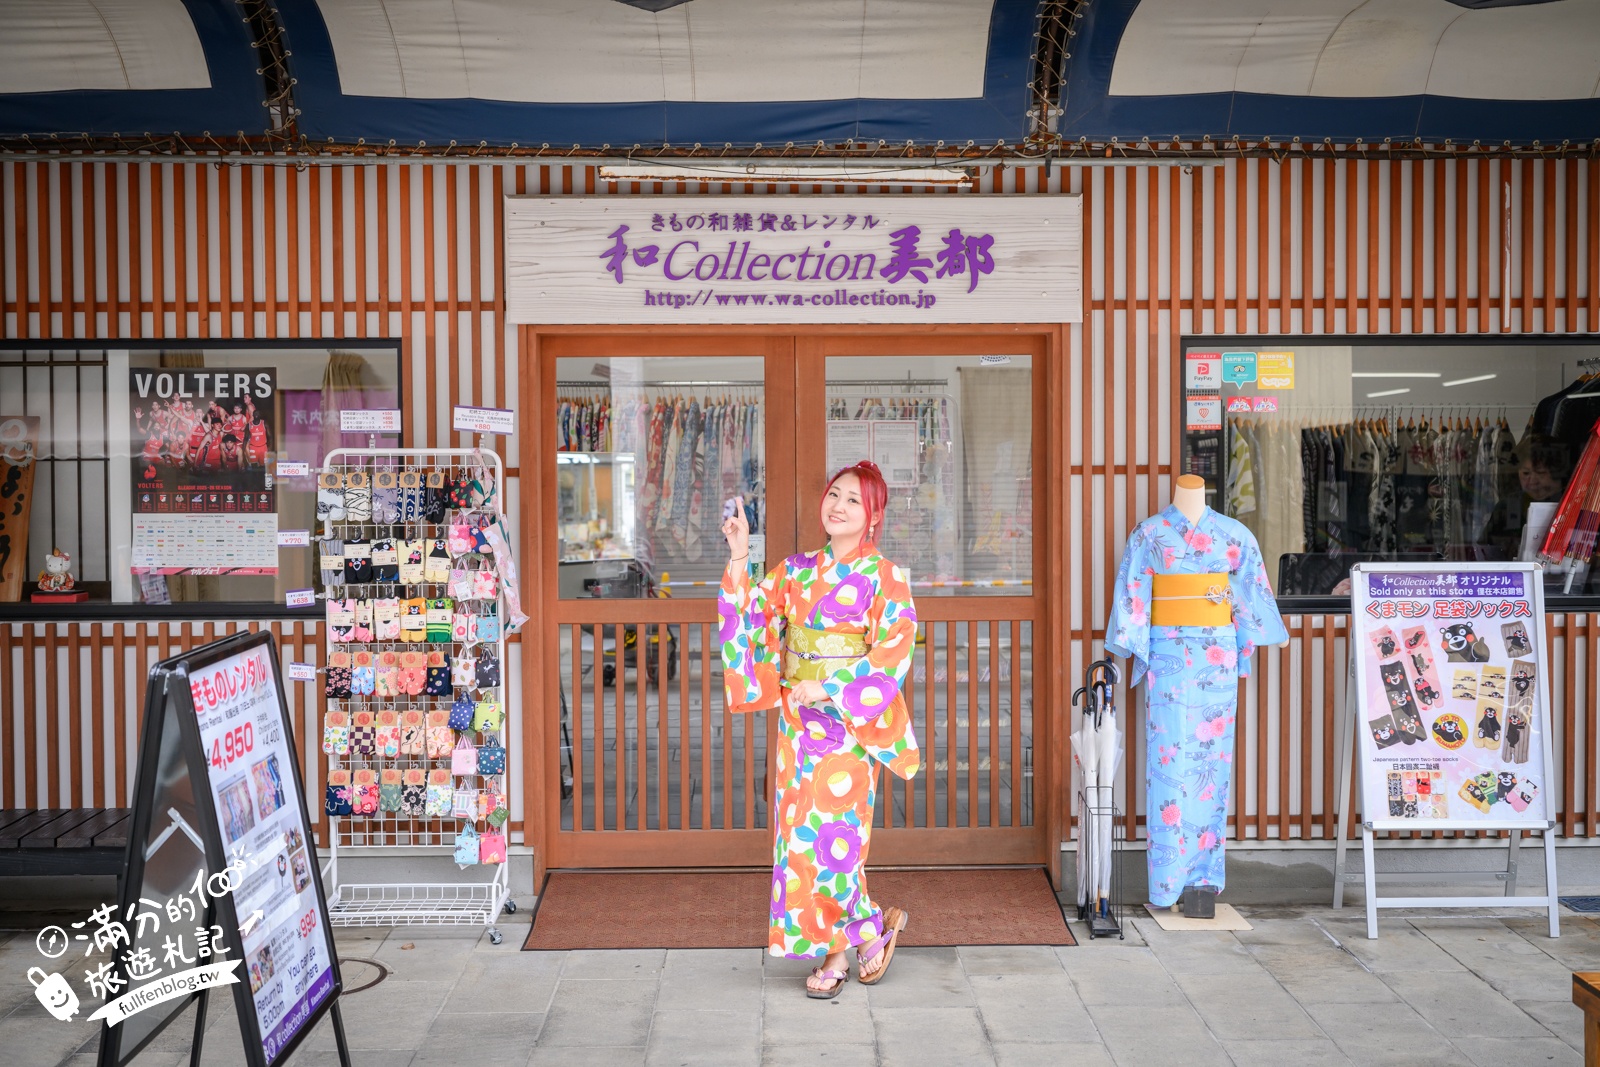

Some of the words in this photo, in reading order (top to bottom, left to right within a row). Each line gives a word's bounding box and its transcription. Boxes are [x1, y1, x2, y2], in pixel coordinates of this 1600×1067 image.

[651, 213, 880, 232] きもの和雑貨&レンタル
[599, 224, 995, 293] 和Collection美都
[644, 289, 936, 309] http://www.wa-collection.jp
[135, 373, 272, 398] VOLTERS
[1370, 588, 1391, 596] Sold
[1393, 588, 1413, 597] only
[1416, 588, 1426, 596] at
[1429, 588, 1446, 596] this
[1449, 588, 1474, 596] store
[1460, 575, 1511, 585] オリジナル
[1366, 601, 1430, 618] くまモン
[1434, 600, 1532, 618] 足袋ソックス
[190, 655, 267, 712] きものレンタル
[1436, 736, 1466, 749] KUMAMOTO
[296, 908, 317, 940] ¥990
[287, 966, 300, 980] You
[309, 946, 316, 962] go
[294, 963, 319, 995] anywhere
[256, 985, 276, 1014] Return
[275, 979, 284, 994] by
[263, 1000, 285, 1029] 5:00pm
